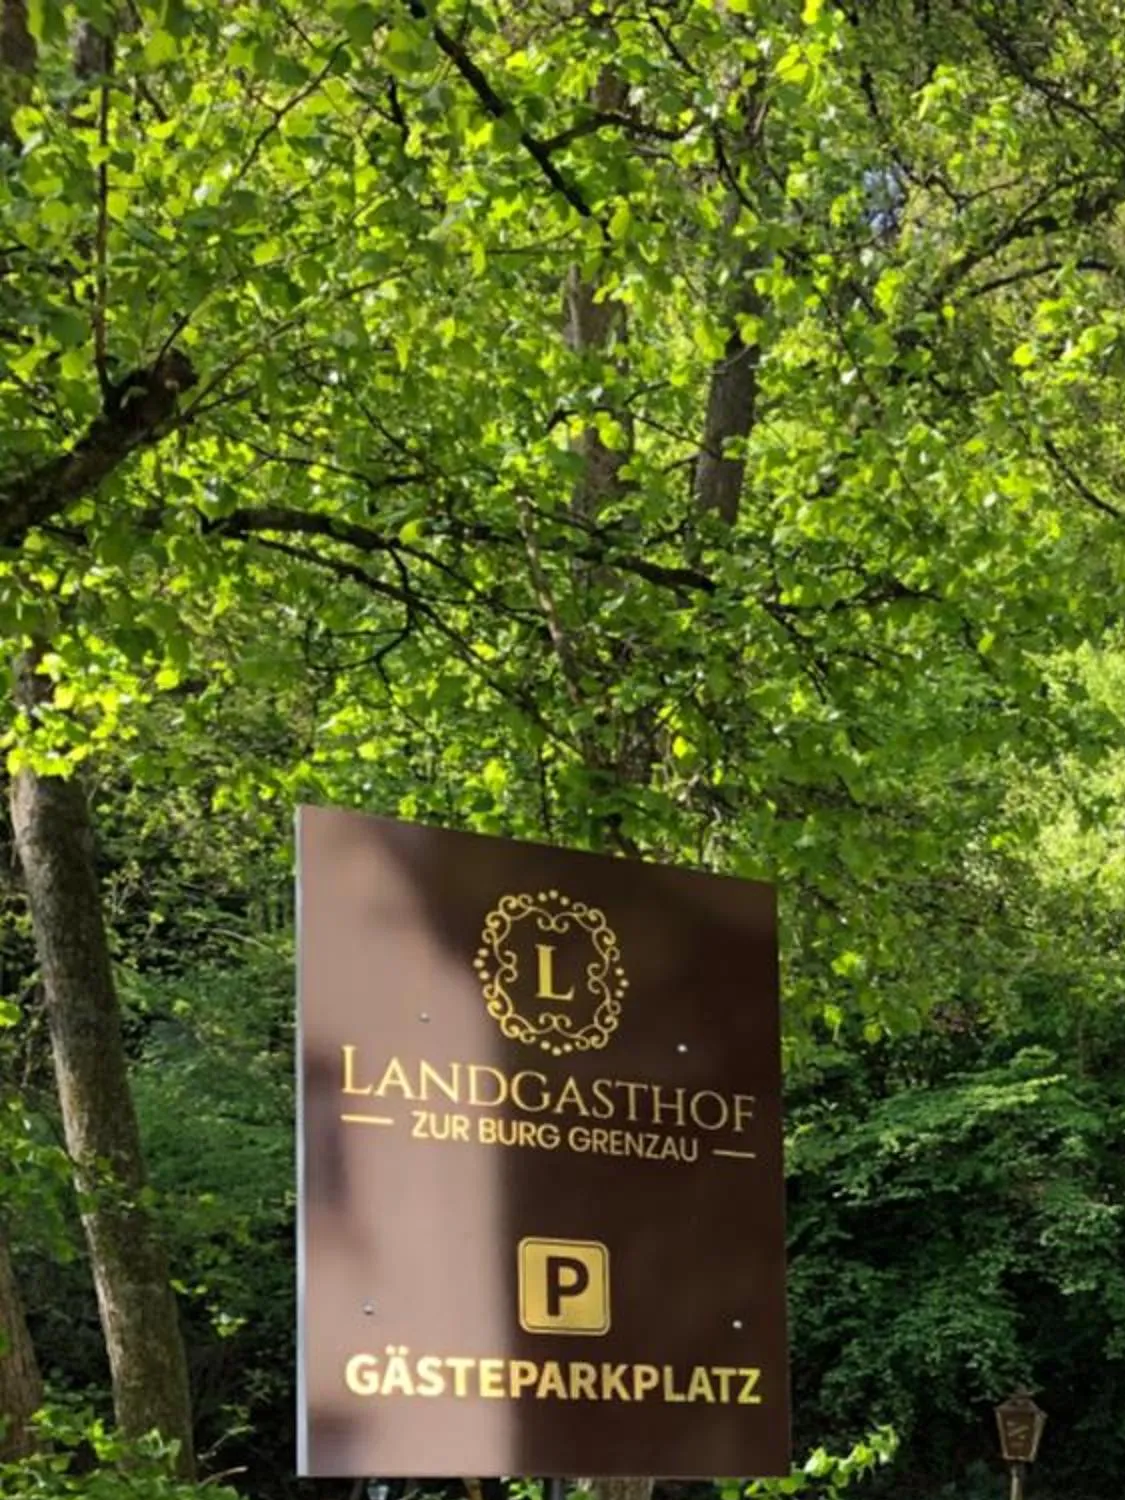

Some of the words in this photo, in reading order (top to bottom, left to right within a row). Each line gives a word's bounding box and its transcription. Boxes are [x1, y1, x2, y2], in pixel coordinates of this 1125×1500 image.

[536, 945, 574, 999] L
[341, 1045, 755, 1132] LANDGASTHOF
[412, 1111, 470, 1140] ZUR
[479, 1119, 560, 1149] BURG
[568, 1127, 698, 1162] GRENZAU
[546, 1256, 590, 1316] P
[345, 1346, 761, 1403] GÄSTEPARKPLATZ
